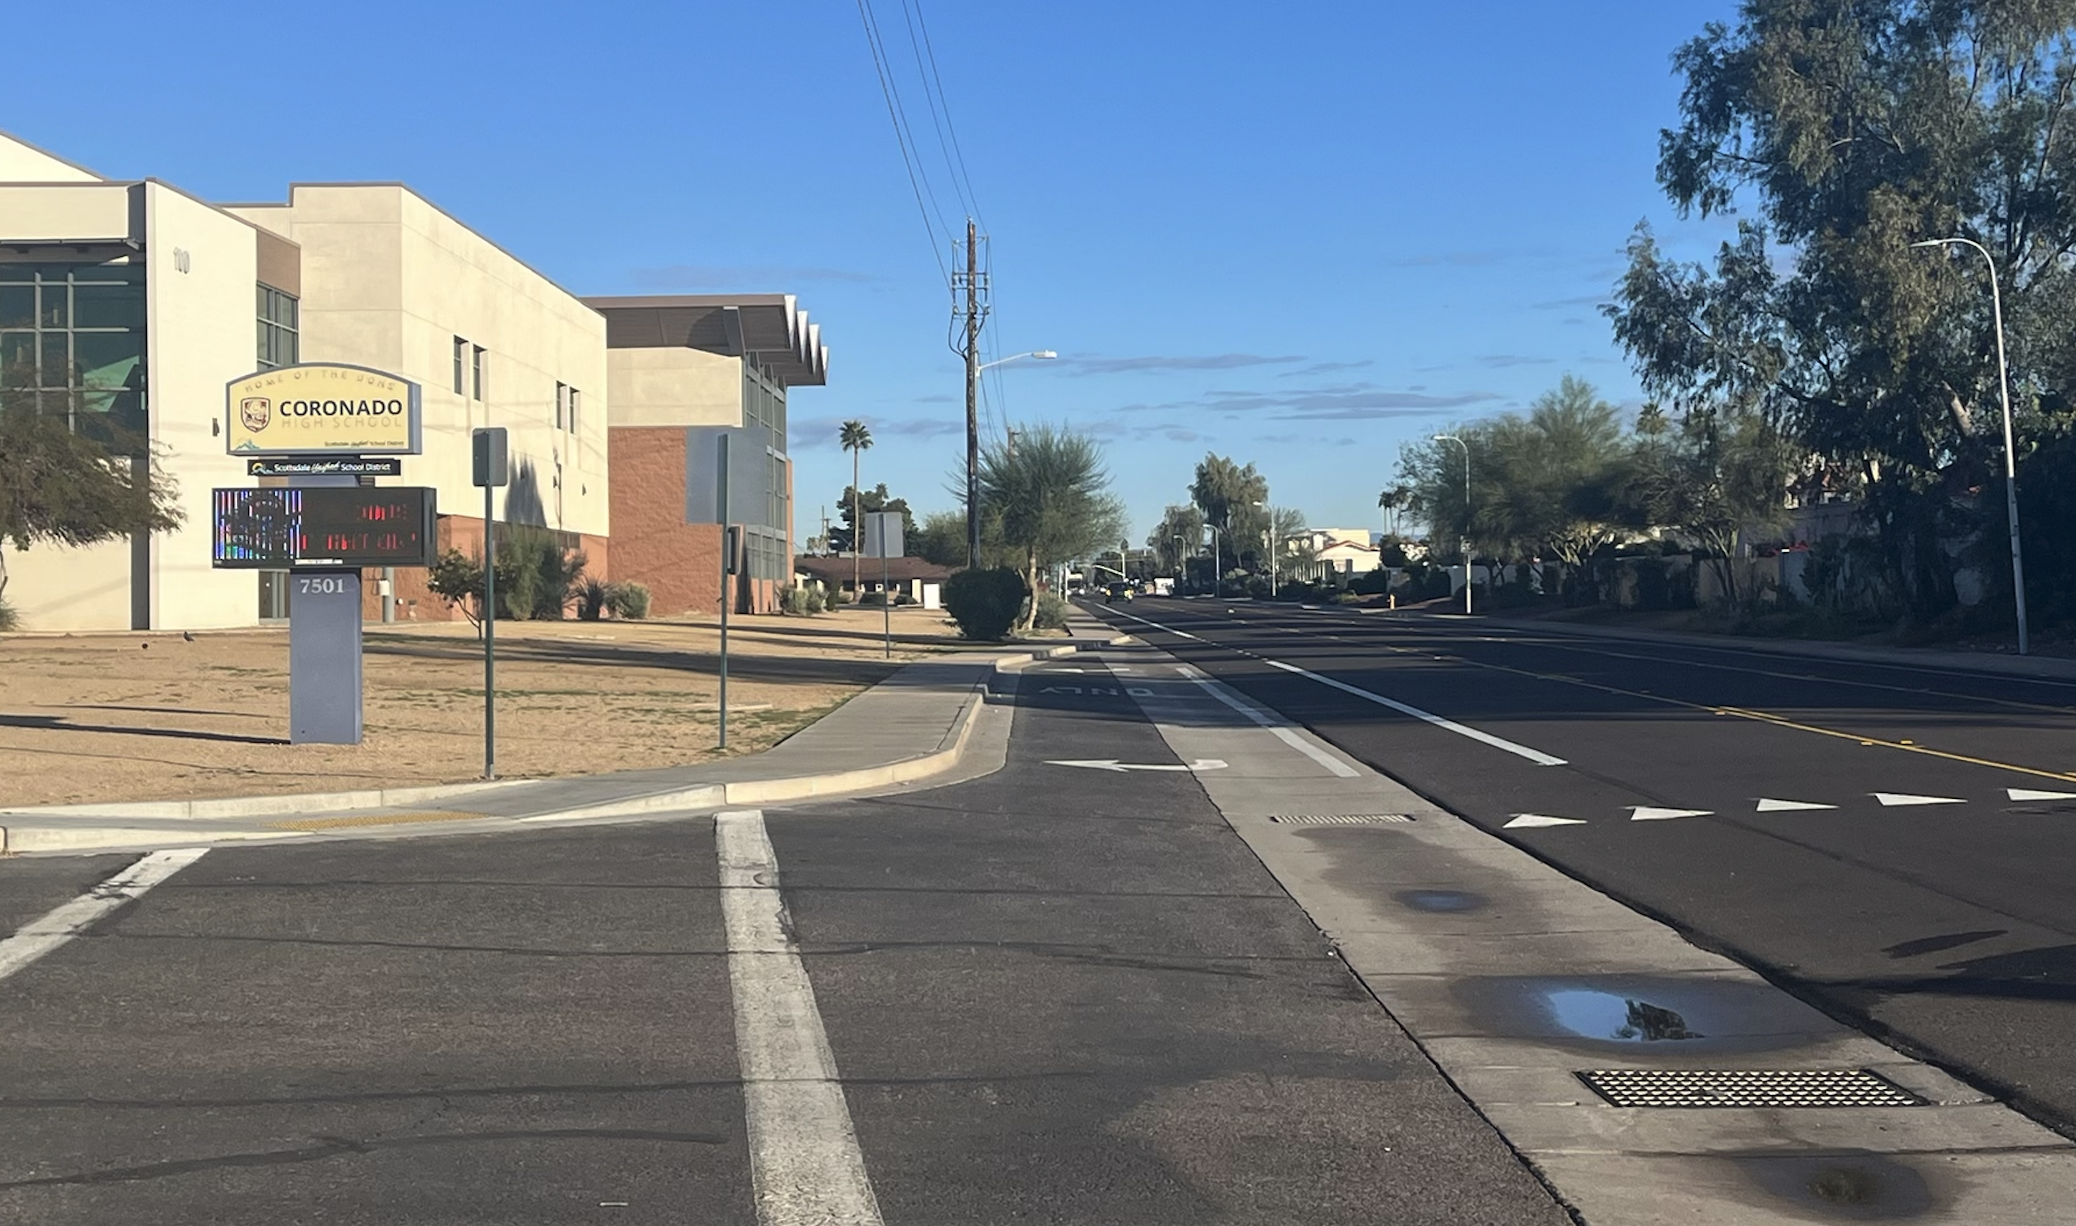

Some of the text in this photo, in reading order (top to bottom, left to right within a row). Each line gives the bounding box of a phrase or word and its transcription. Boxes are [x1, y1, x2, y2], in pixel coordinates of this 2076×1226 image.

[244, 369, 395, 393] HOME OF THE DONS
[279, 399, 403, 417] CORONADO
[281, 416, 403, 429] HIGH SCHOOL
[274, 463, 311, 472] Scottsdale
[340, 463, 365, 472] School
[365, 463, 391, 472] District
[300, 578, 345, 594] 7501
[1039, 686, 1154, 697] ONLY
